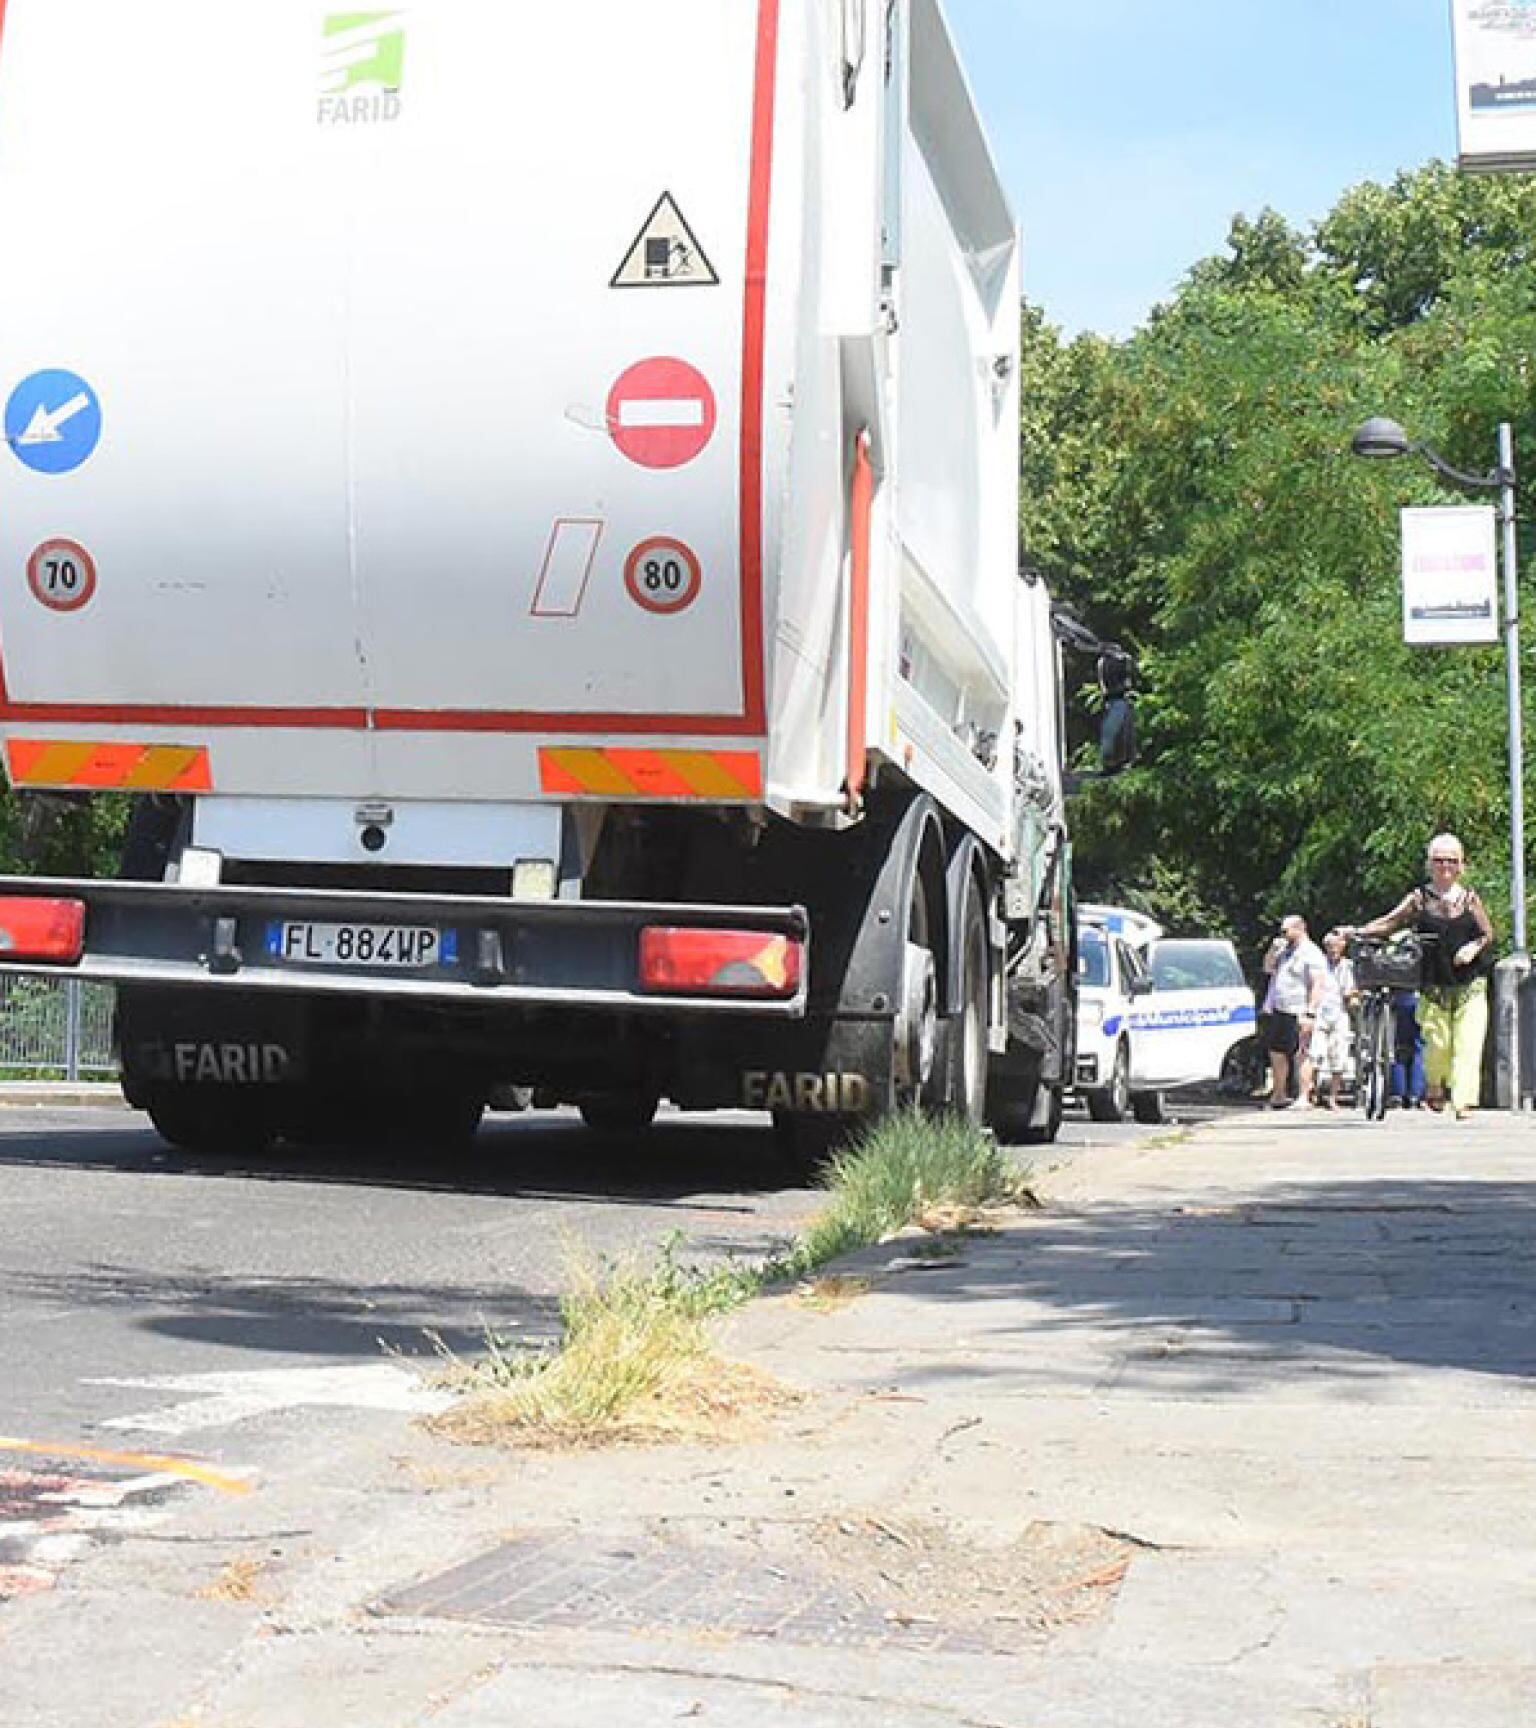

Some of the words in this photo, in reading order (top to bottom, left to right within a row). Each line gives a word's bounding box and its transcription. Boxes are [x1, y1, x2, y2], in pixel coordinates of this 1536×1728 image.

[317, 96, 402, 124] FARID
[46, 561, 77, 589] 70
[644, 559, 681, 591] 80
[287, 925, 321, 958] FL
[336, 927, 437, 962] 884WP
[175, 1043, 290, 1082] FARID
[743, 1071, 868, 1112] FARID
